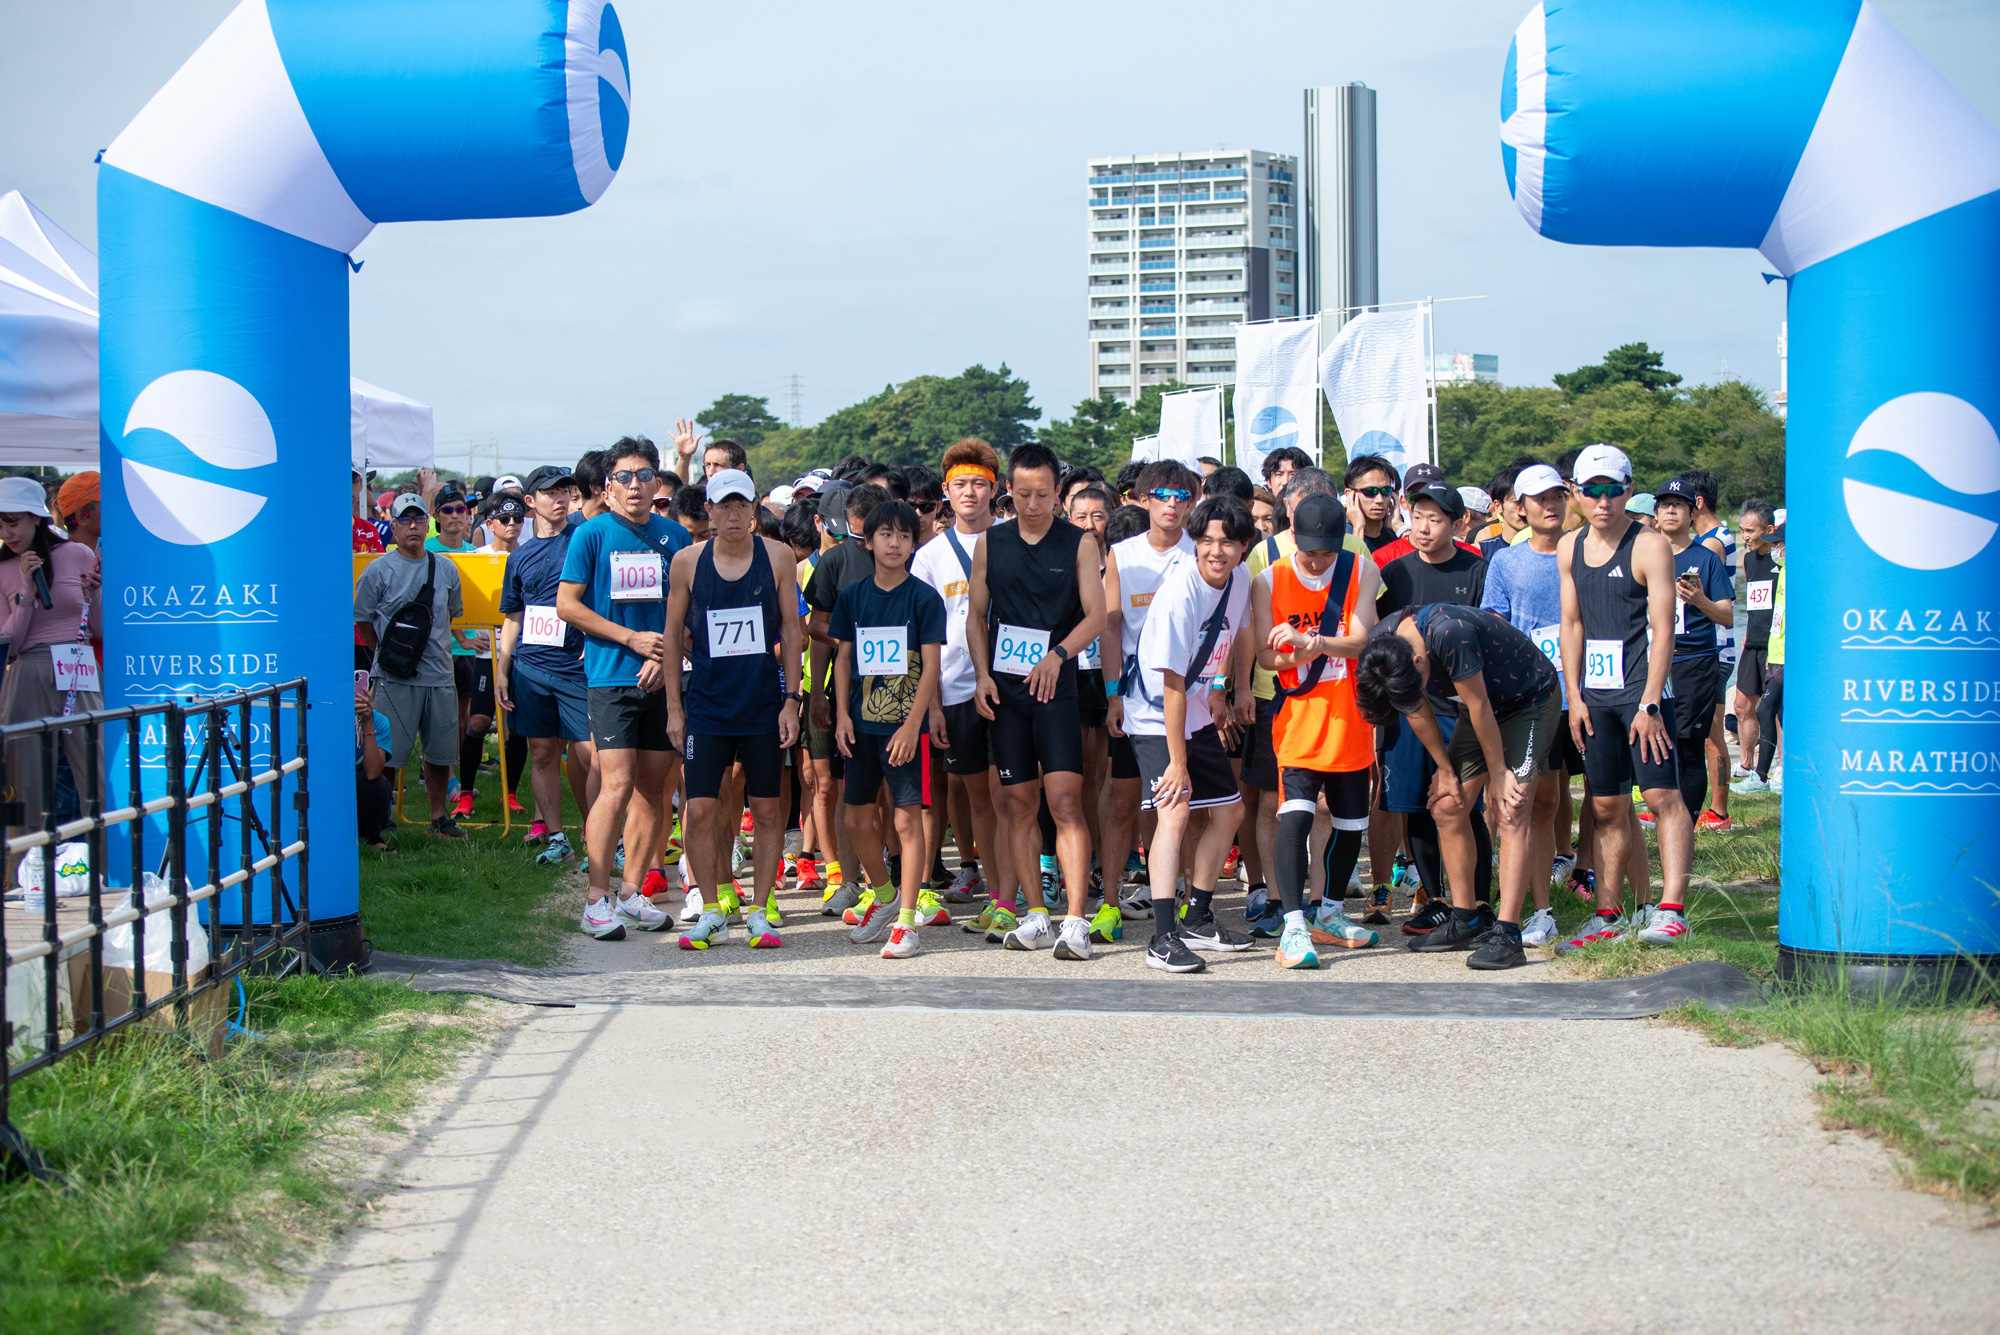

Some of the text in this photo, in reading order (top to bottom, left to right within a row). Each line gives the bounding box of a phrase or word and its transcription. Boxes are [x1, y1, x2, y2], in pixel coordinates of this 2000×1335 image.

[618, 566, 657, 588] 1013
[123, 583, 278, 607] OKAZAKI
[1749, 588, 1769, 603] 437
[529, 616, 561, 637] 1061
[714, 619, 756, 645] 771
[1843, 609, 2000, 632] OKAZAK
[863, 639, 901, 664] 912
[1000, 637, 1043, 666] 948
[125, 653, 279, 676] RIVERSIDE
[1588, 653, 1614, 677] 931
